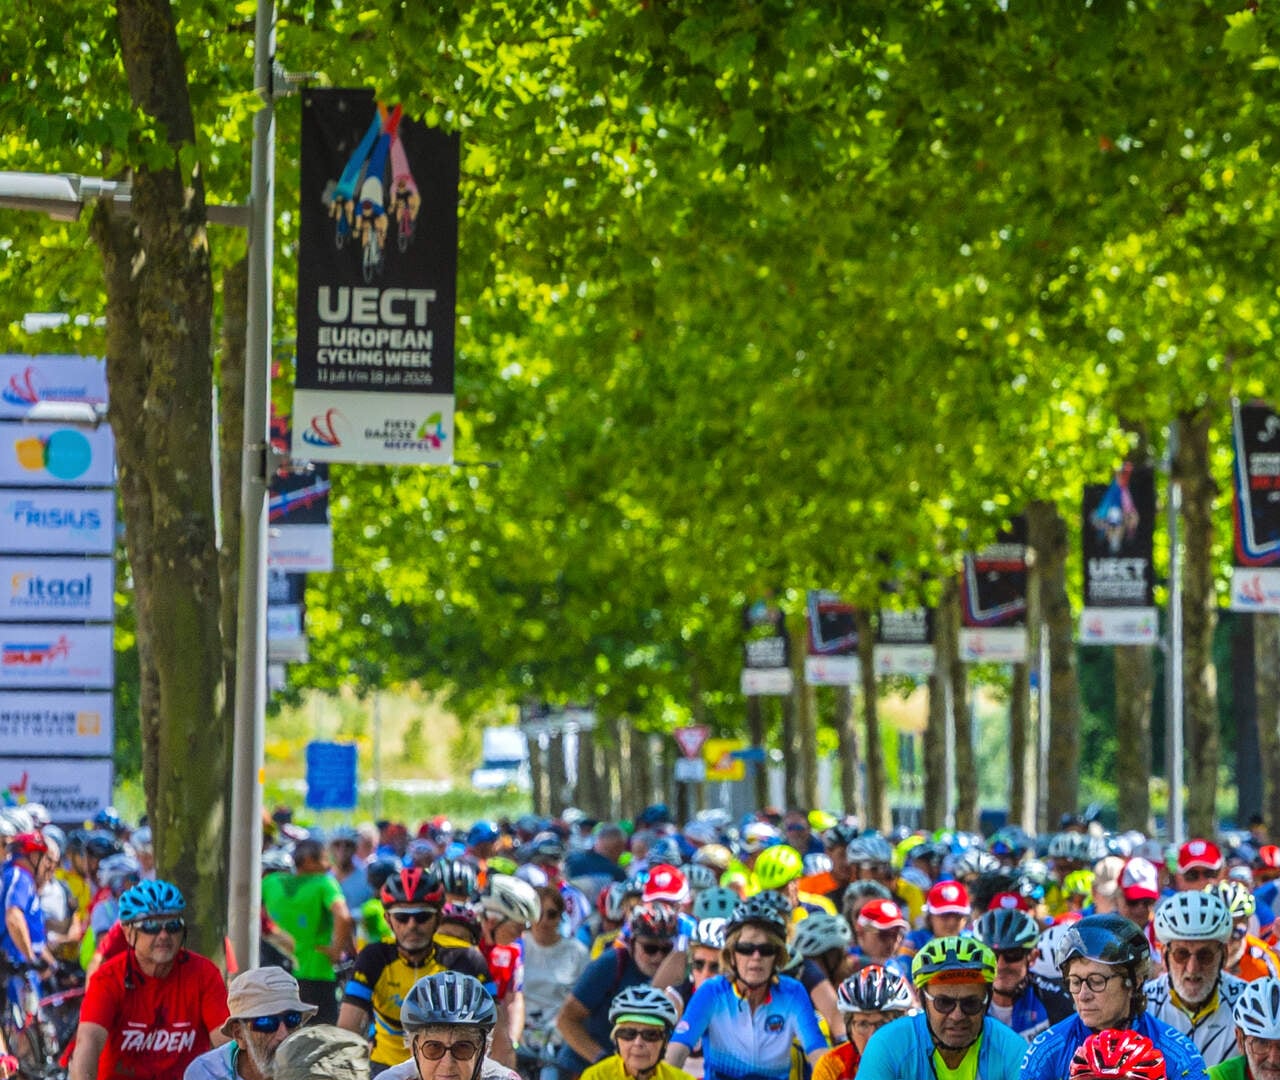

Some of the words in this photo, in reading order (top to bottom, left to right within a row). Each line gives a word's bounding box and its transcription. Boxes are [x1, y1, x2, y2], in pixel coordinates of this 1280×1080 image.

[317, 285, 437, 326] UECT
[318, 326, 433, 349] EUROPEAN
[317, 348, 383, 367] CYCLING
[385, 351, 432, 368] WEEK
[120, 1028, 197, 1053] TANDEM
[1020, 1028, 1054, 1070] UECT
[1164, 1027, 1201, 1060] UECT
